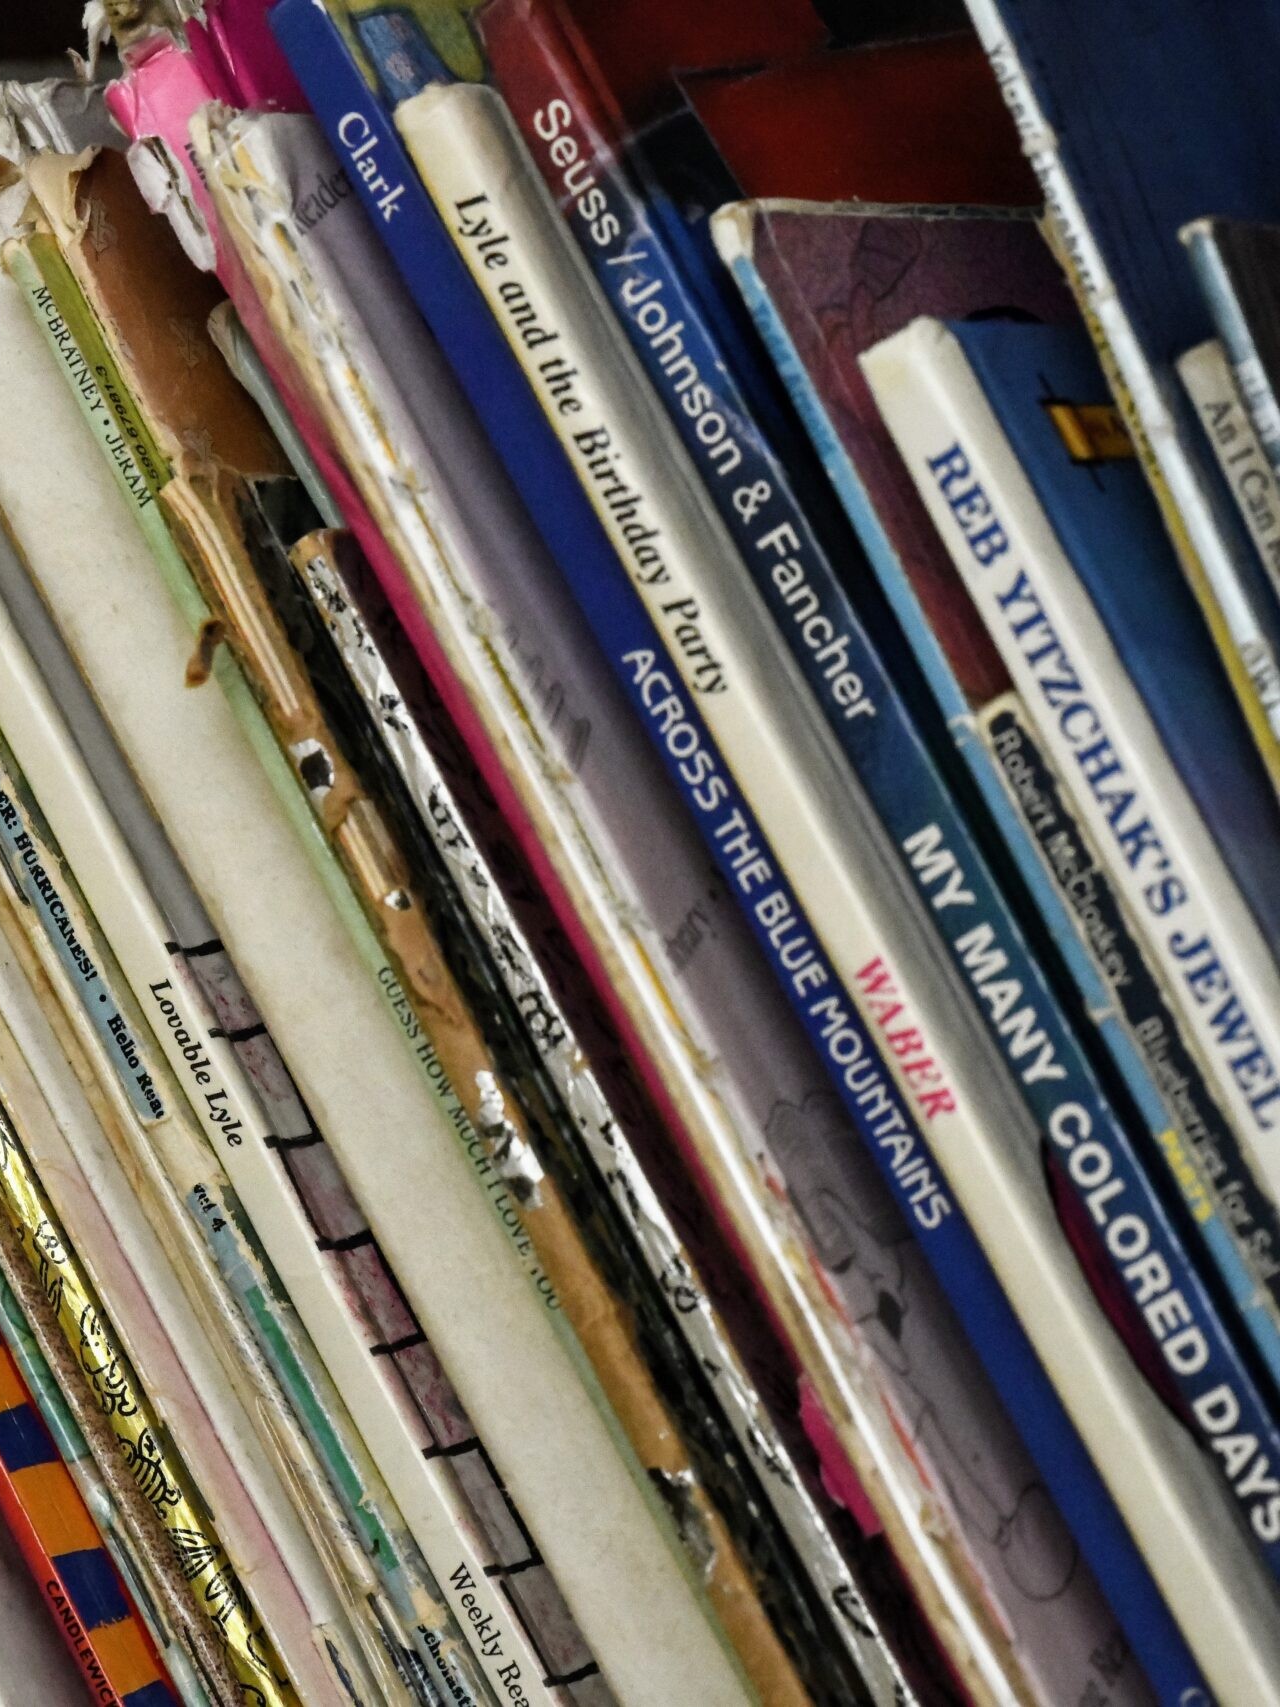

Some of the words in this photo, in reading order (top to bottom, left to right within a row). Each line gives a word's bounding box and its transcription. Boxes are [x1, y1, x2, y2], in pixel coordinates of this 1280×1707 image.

[330, 106, 413, 224] Clark
[526, 95, 634, 249] Seuss
[444, 188, 518, 277] Lyle
[495, 272, 559, 353] and
[535, 350, 593, 419] the
[564, 420, 682, 594] Birthday
[652, 590, 738, 704] Party
[616, 266, 754, 477] Johnson
[1202, 394, 1244, 448] An
[1225, 446, 1253, 467] I
[103, 430, 154, 509] JERAM
[727, 475, 779, 525] &
[1234, 466, 1280, 534] Can
[750, 520, 886, 728] Fancher
[923, 441, 1013, 569] REB
[988, 571, 1189, 922] YITZCHAK'S
[1165, 922, 1280, 1133] JEWEL
[989, 727, 1062, 834] Robert
[1040, 829, 1142, 992] McCloskey
[620, 643, 732, 815] ACROSS
[707, 808, 774, 894] THE
[750, 889, 830, 998] BLUE
[806, 994, 954, 1233] MOUNTAINS
[11, 830, 100, 983] HURRICANES!
[208, 1214, 229, 1235] 4
[147, 976, 217, 1088] Lovable
[203, 1088, 248, 1150] Lyle
[373, 965, 424, 1041] GUESS
[414, 1043, 455, 1101] HOW
[445, 1103, 494, 1178] MUCH
[492, 1194, 536, 1258] LOVE
[849, 955, 959, 1126] WABER
[897, 821, 977, 921] MY
[950, 922, 1068, 1096] MANY
[1040, 1095, 1216, 1382] COLORED
[1188, 1382, 1280, 1547] DAYS
[1215, 1177, 1260, 1229] for
[440, 1561, 510, 1664] Weekly
